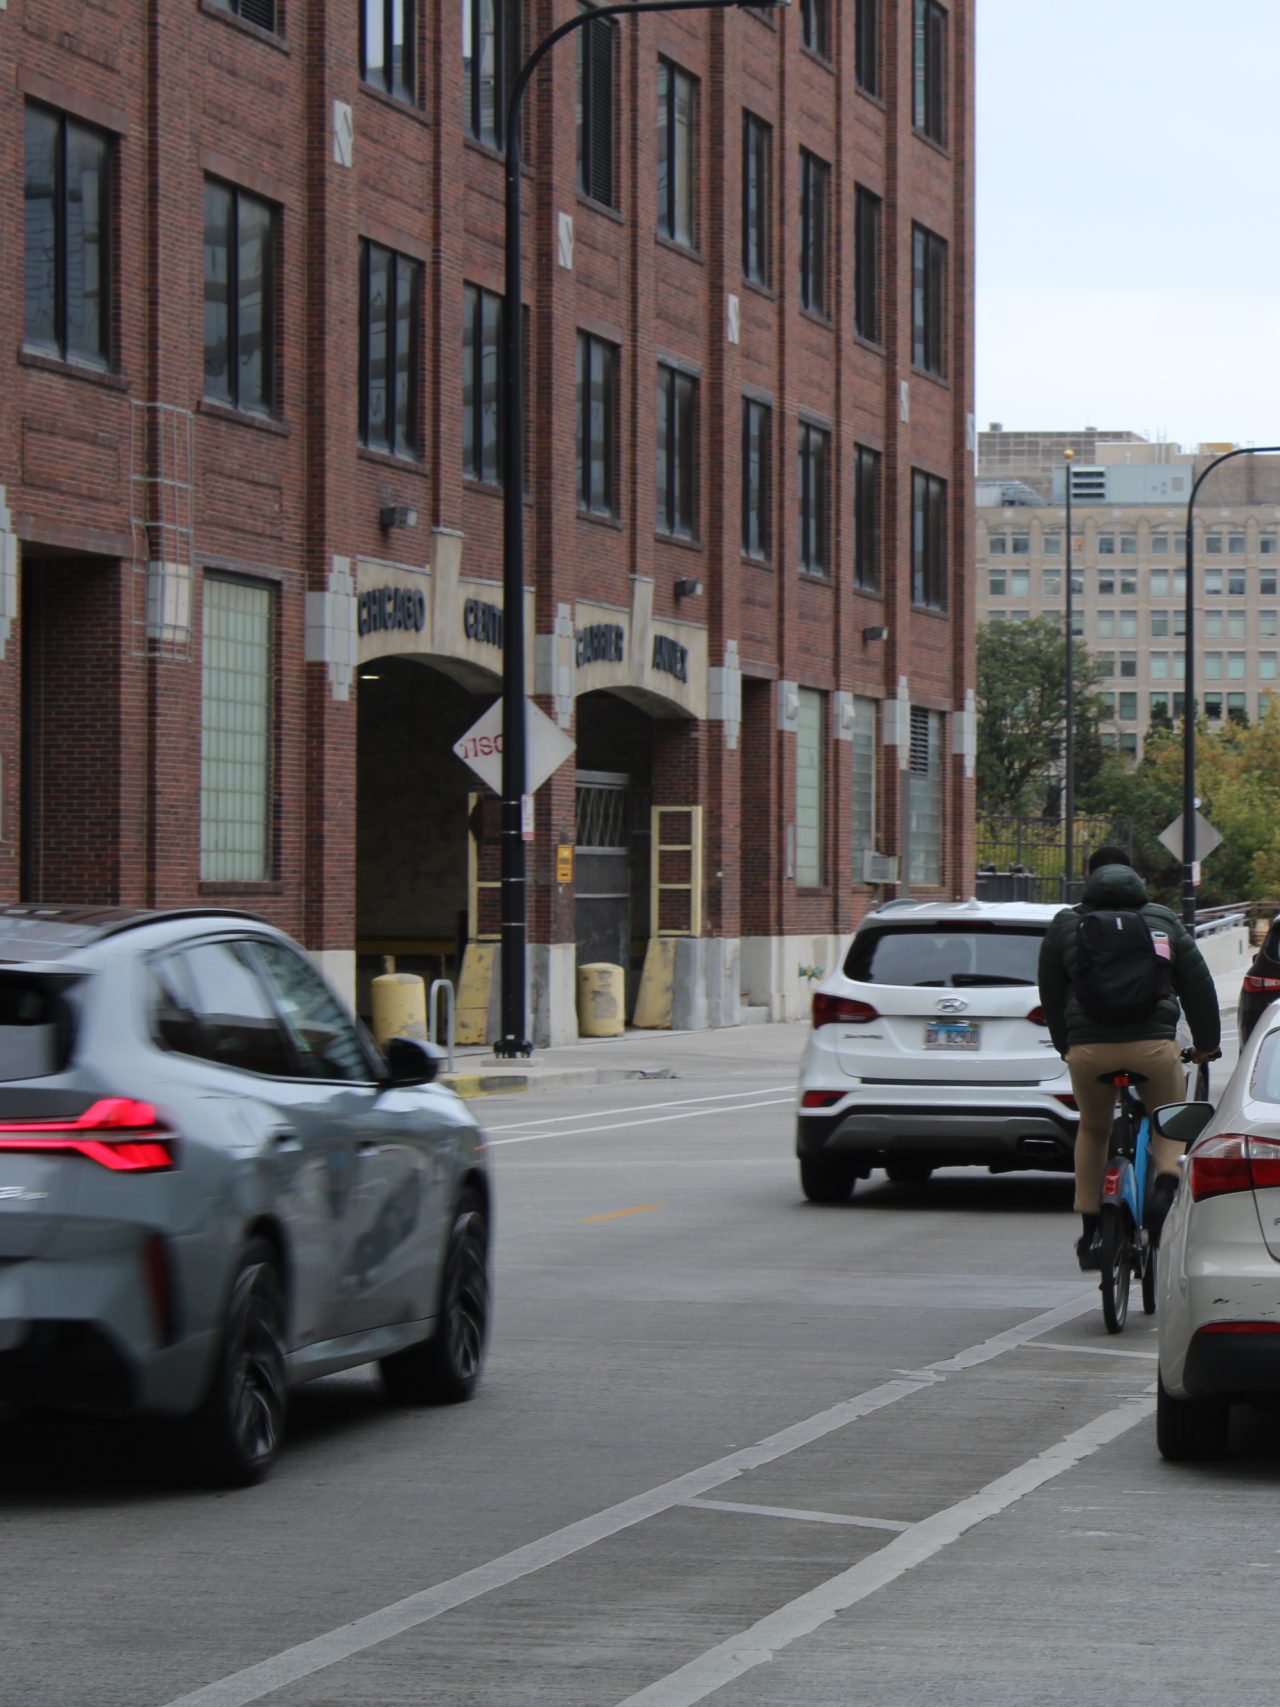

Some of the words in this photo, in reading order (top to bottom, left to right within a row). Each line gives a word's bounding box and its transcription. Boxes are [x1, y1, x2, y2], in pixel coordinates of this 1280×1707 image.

[358, 585, 426, 636] CHICAGO
[464, 598, 504, 649] CENT
[576, 623, 624, 668] CARRIER
[652, 634, 688, 683] ANNEX
